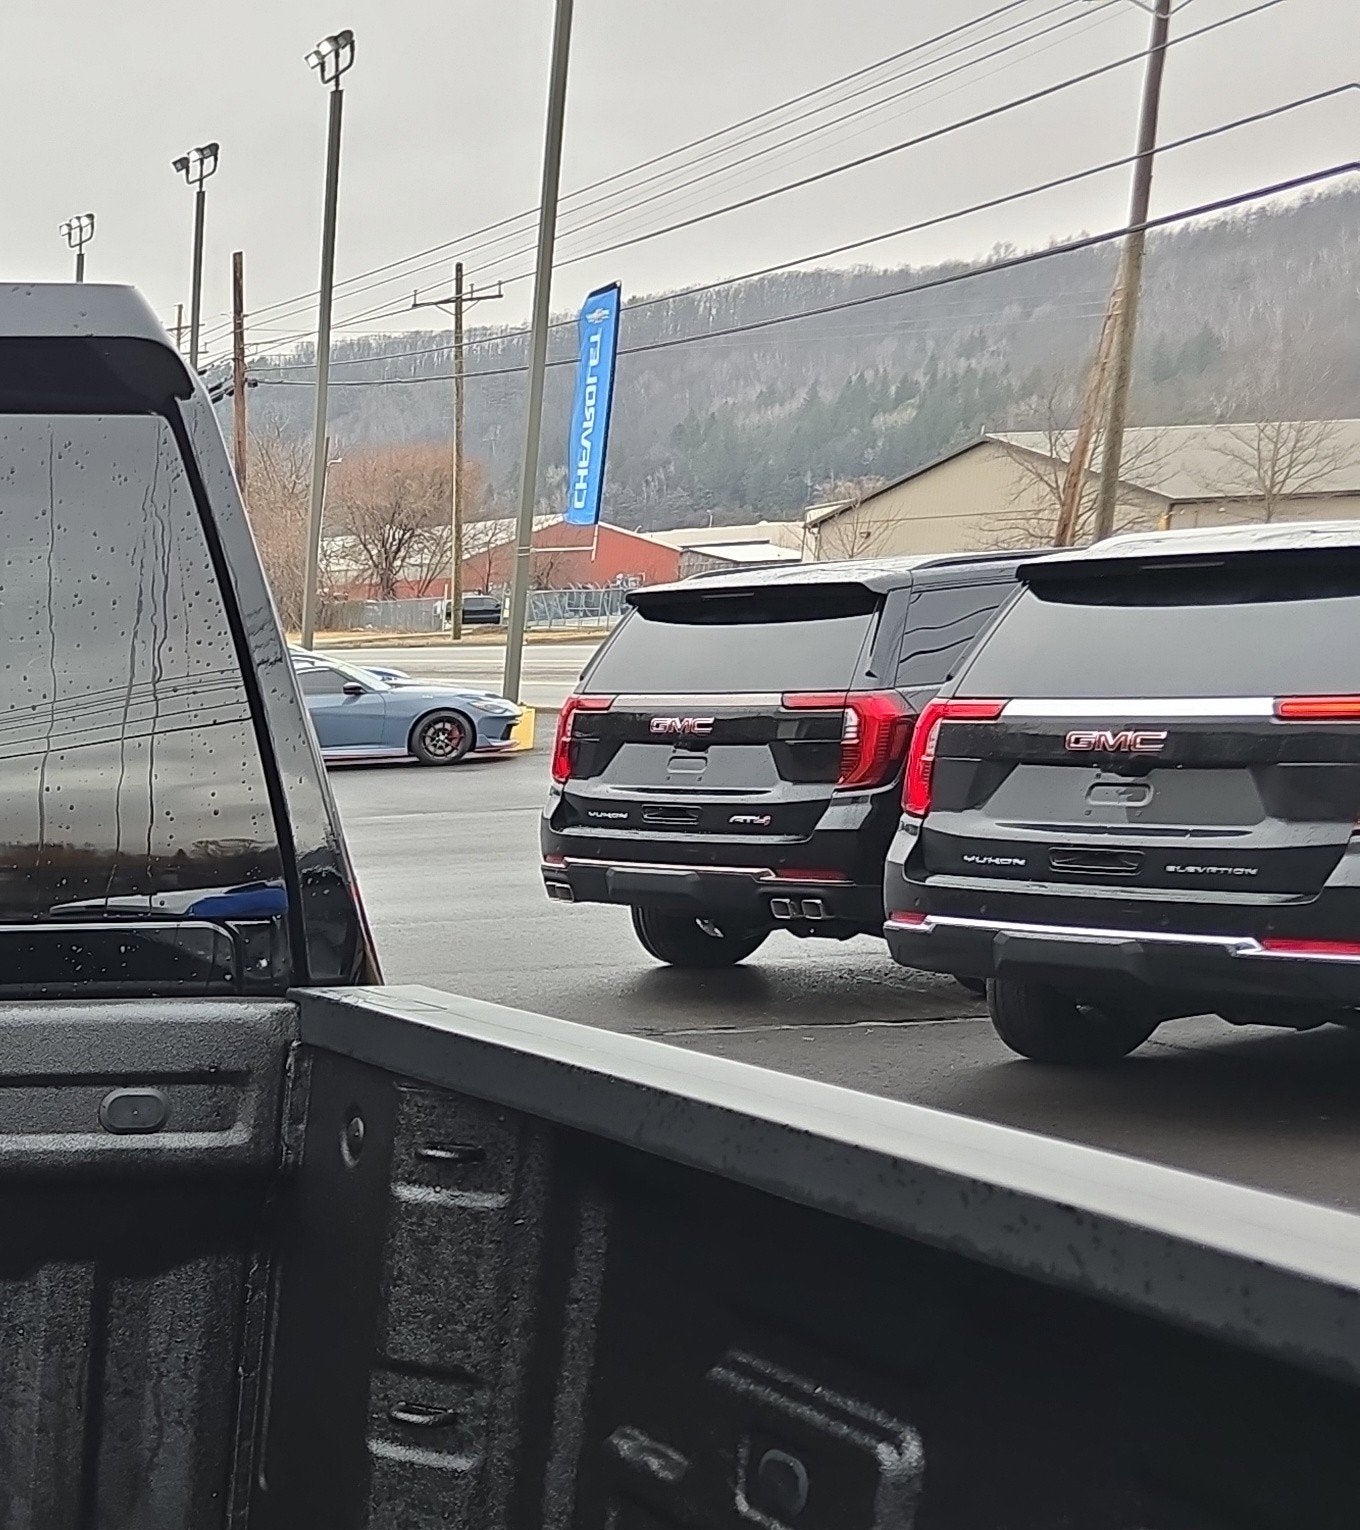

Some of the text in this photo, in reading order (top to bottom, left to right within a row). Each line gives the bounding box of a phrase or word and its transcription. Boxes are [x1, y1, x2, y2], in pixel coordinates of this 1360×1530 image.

[649, 717, 715, 734] GMC
[1065, 730, 1168, 751] GMC
[588, 811, 628, 819] YUKON
[729, 815, 771, 826] AT4
[963, 855, 1026, 866] YUKON
[1165, 865, 1259, 875] ELEVATION
